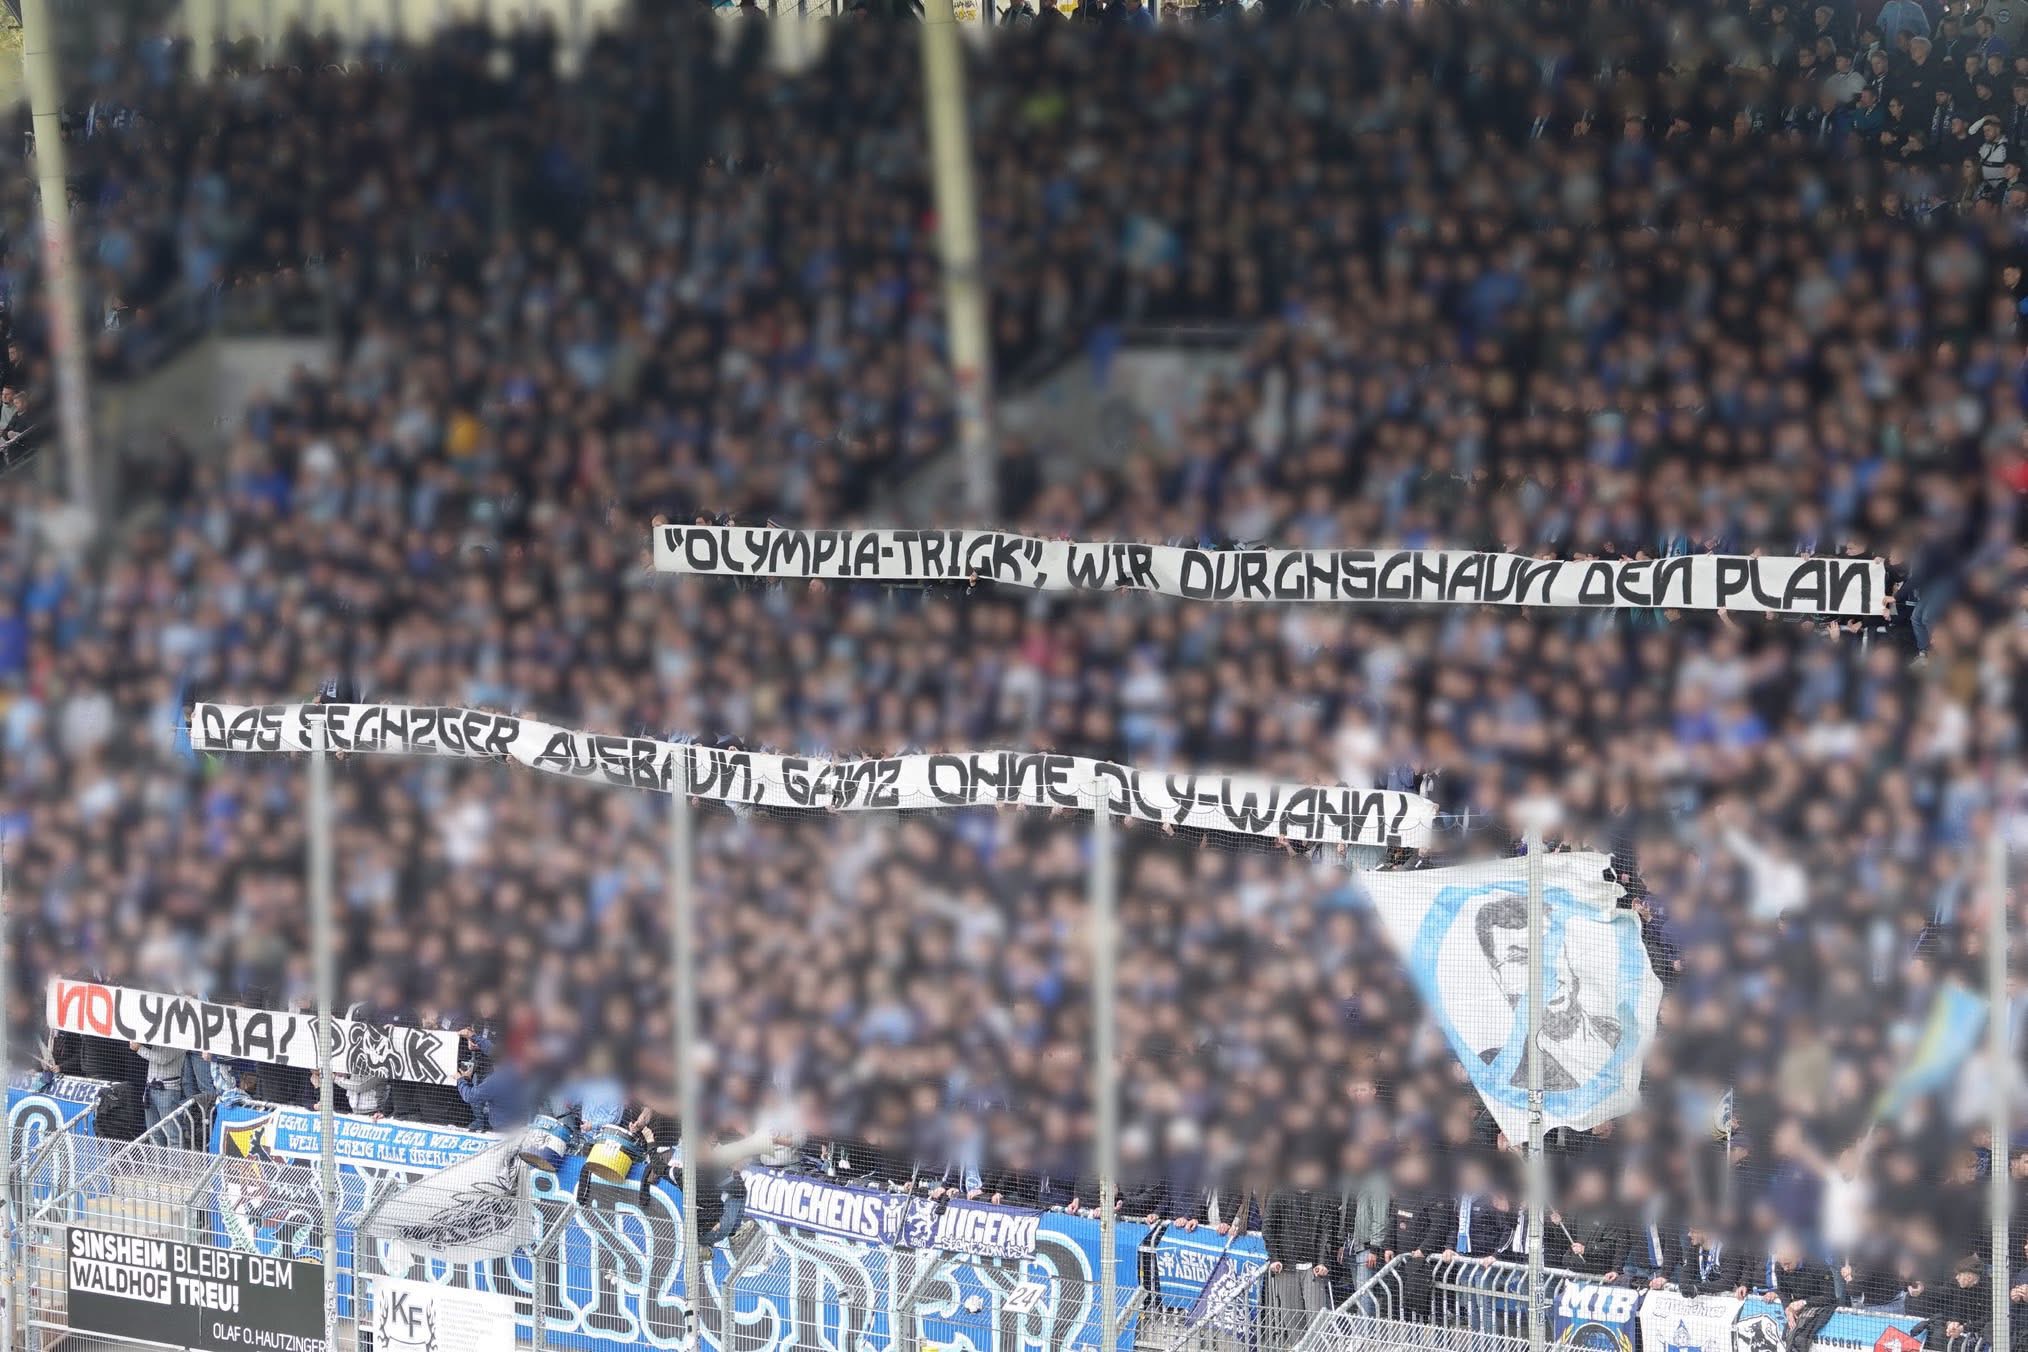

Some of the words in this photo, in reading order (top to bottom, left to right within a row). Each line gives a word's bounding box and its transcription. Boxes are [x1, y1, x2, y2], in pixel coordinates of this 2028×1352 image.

[1067, 543, 1160, 589] WIR
[1578, 556, 1692, 606] DEN
[1717, 557, 1872, 613] PLAN
[201, 704, 287, 751] DAS
[781, 757, 902, 809] GANZ
[928, 753, 1079, 807] OHNE
[278, 1114, 308, 1131] EGAL
[313, 1117, 340, 1136] WR
[393, 1129, 427, 1147] EGAL
[288, 1134, 319, 1151] WEIL
[378, 1144, 407, 1161] ALLE
[739, 1170, 883, 1238] MÜNCHENS
[934, 1206, 1040, 1253] JUGEND
[71, 1229, 168, 1270] SINSHEIM
[173, 1245, 244, 1282] BLEIBT
[249, 1256, 293, 1290] DEM
[72, 1260, 169, 1301] WALDHOF
[176, 1276, 240, 1314] TREU!
[1008, 1286, 1037, 1308] 24
[213, 1322, 241, 1342] OLAF
